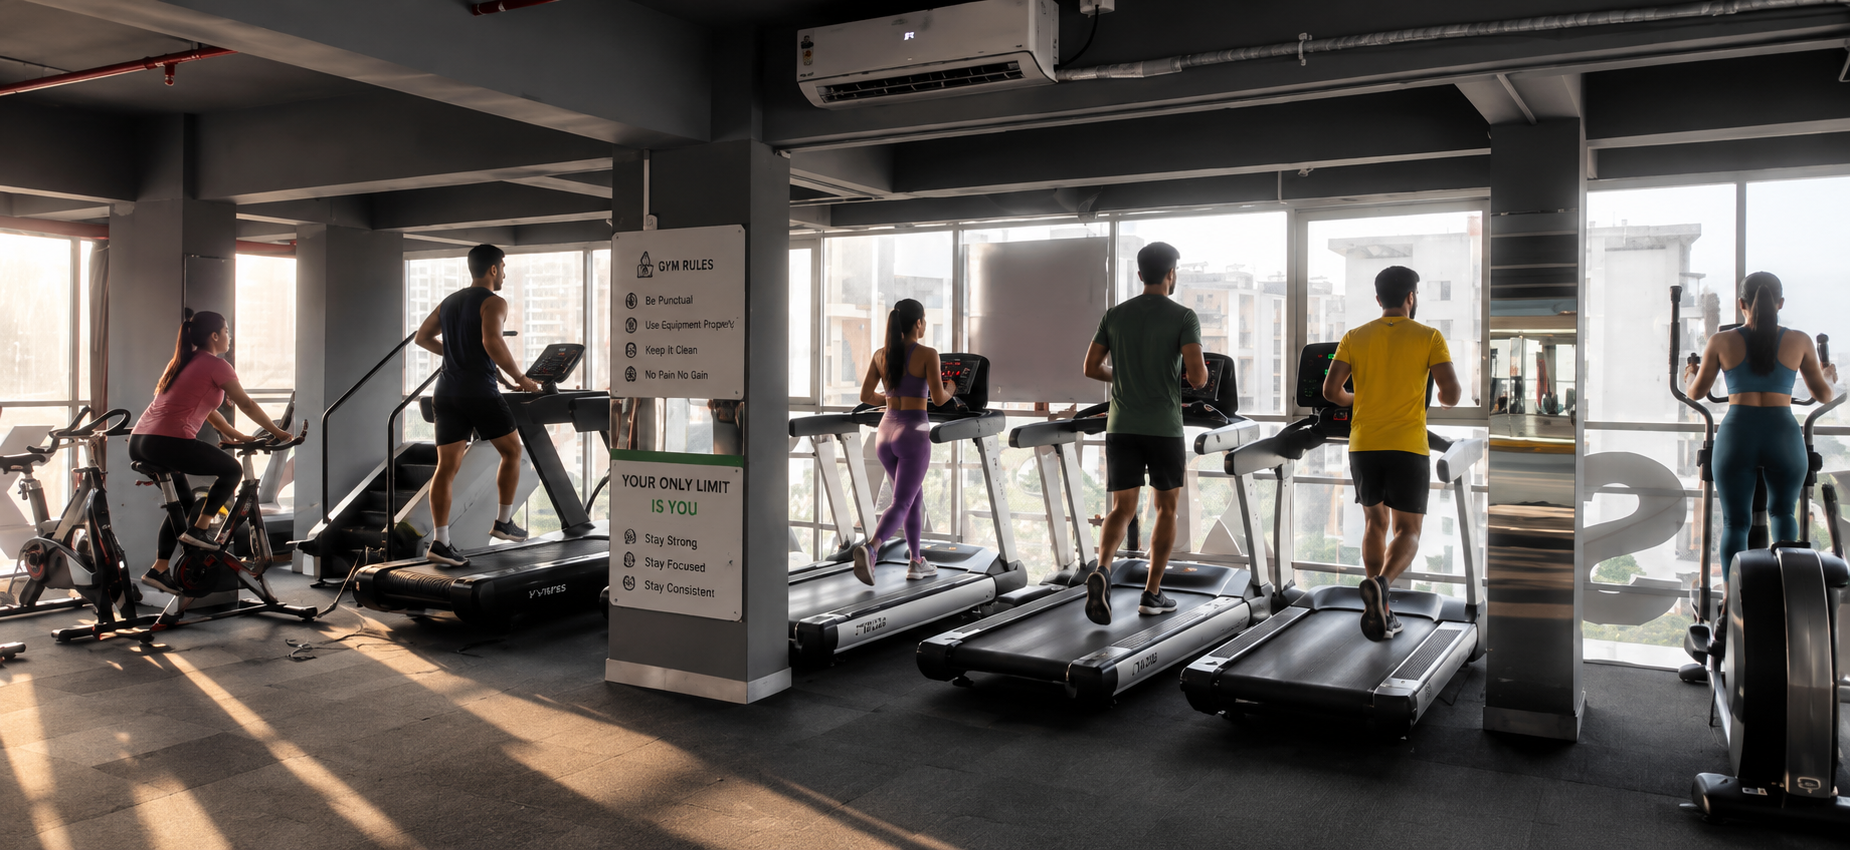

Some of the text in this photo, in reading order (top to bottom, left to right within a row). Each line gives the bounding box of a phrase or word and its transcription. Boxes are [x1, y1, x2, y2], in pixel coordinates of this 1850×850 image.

[658, 259, 714, 272] GYM RULES
[646, 295, 693, 305] Be Punctual
[646, 321, 659, 329] Use
[662, 320, 701, 331] Equipment
[646, 346, 665, 357] Keep
[676, 345, 698, 354] Clean
[646, 371, 708, 380] No Pain No Gain
[622, 474, 730, 493] YOUR ONLY LIMIT
[651, 499, 697, 516] IS YOU
[645, 534, 697, 550] Stay Strong
[645, 557, 705, 572] Stay Focused
[645, 581, 714, 598] Stay Consistent
